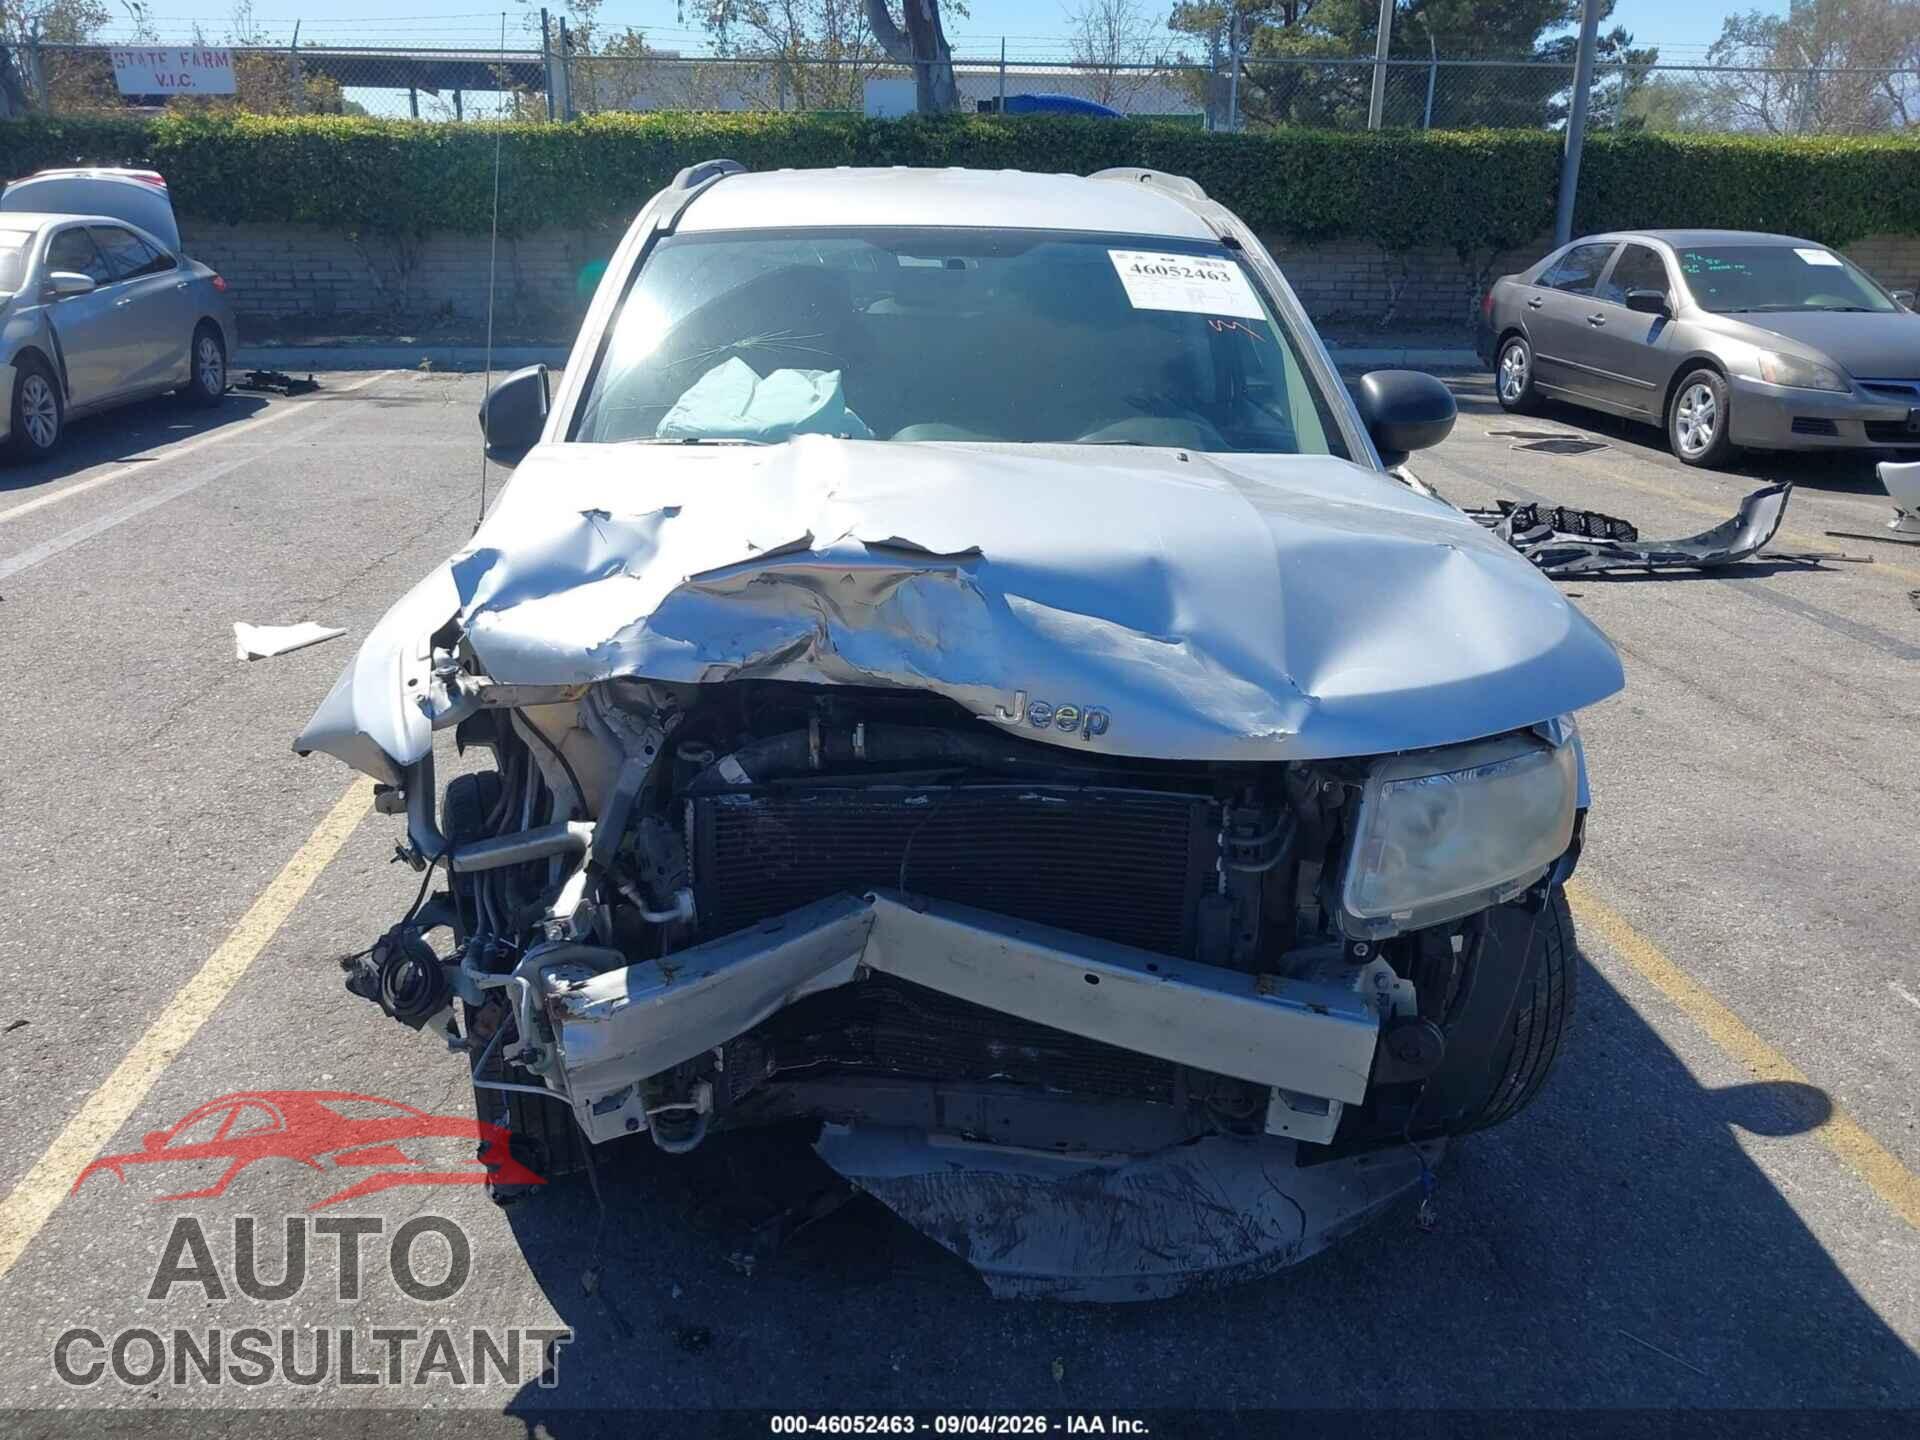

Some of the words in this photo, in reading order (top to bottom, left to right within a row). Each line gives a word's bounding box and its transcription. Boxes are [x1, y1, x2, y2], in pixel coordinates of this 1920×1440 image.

[114, 52, 168, 69] STATE
[180, 52, 229, 69] FARM
[155, 73, 197, 88] V.I.C.
[1130, 263, 1232, 282] 46052463
[994, 690, 1111, 742] Jeep
